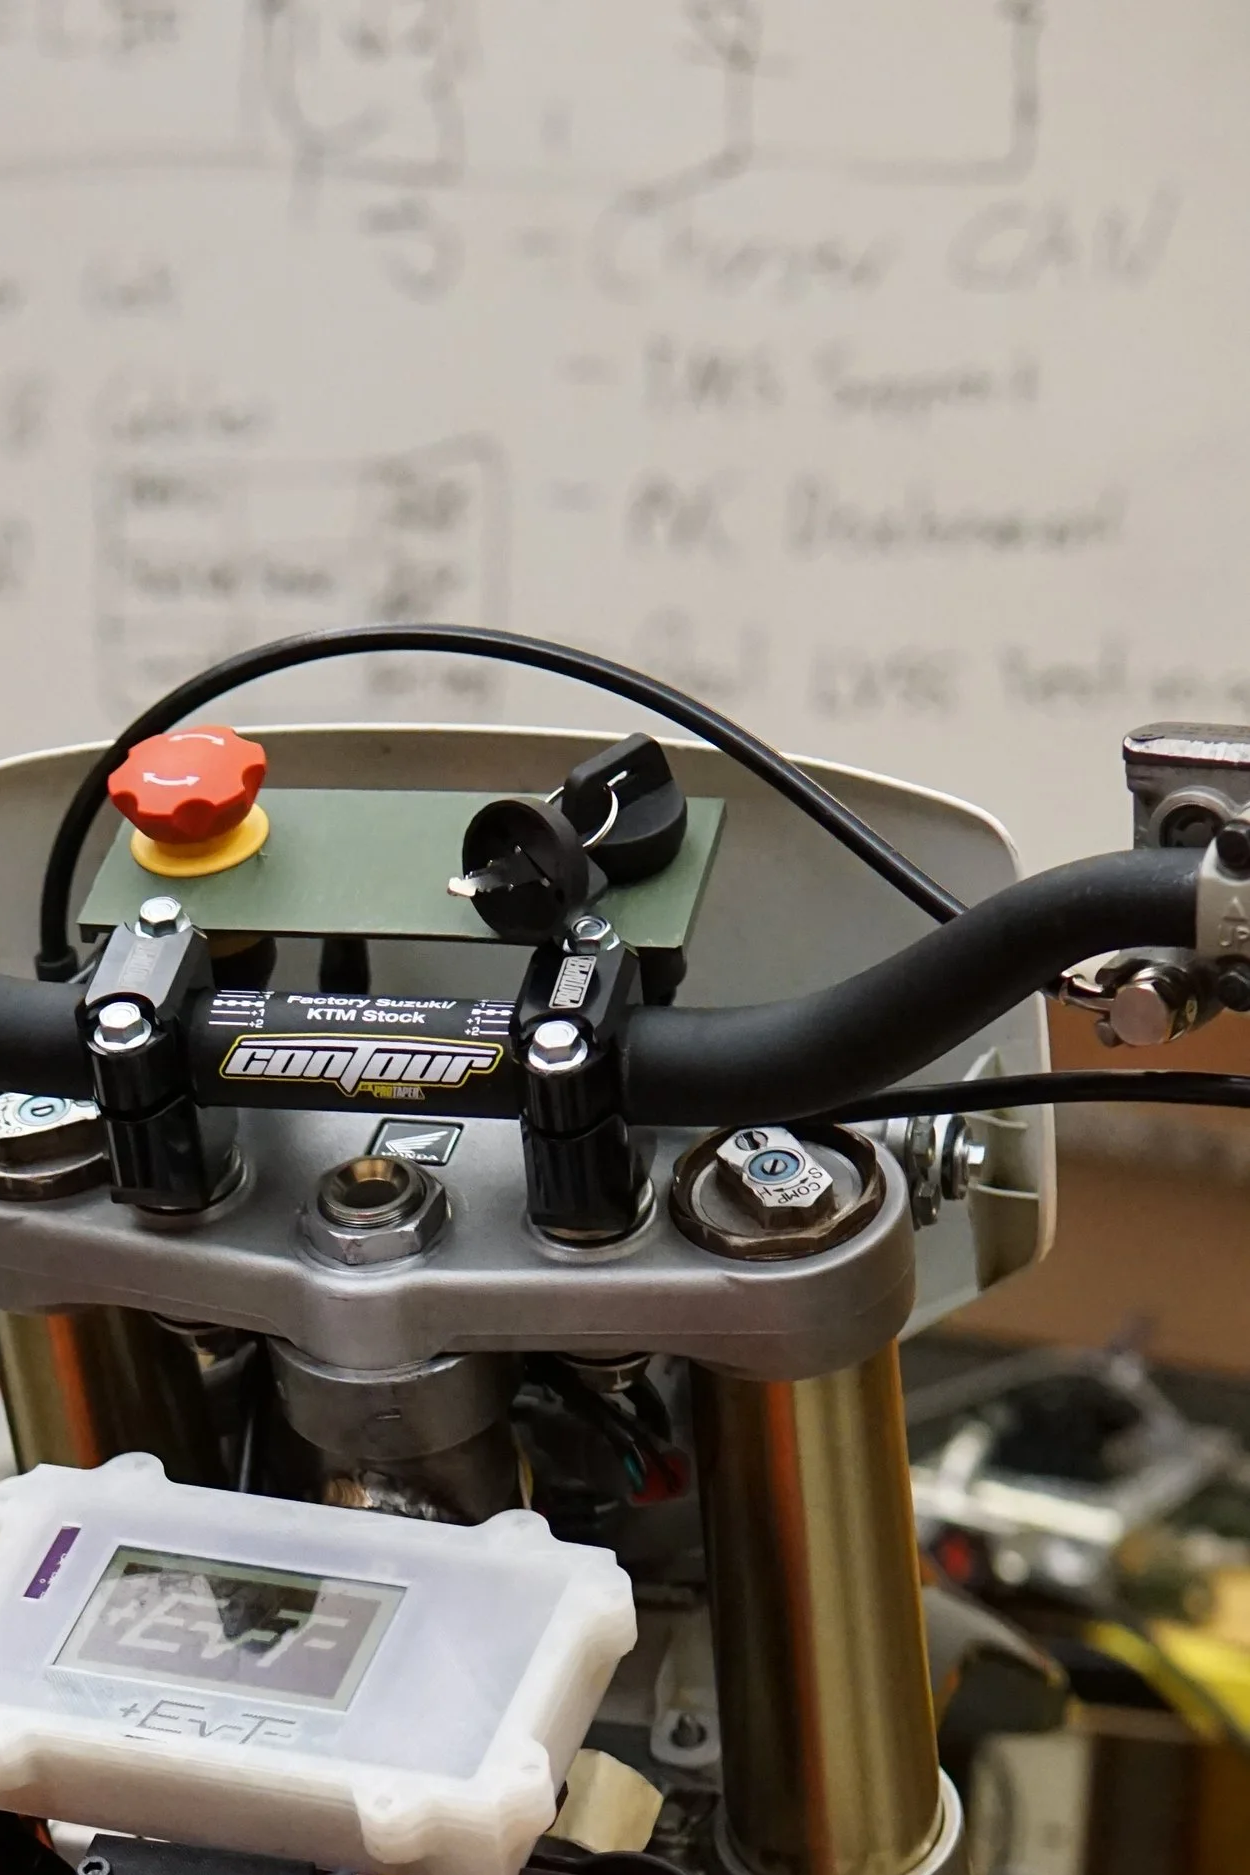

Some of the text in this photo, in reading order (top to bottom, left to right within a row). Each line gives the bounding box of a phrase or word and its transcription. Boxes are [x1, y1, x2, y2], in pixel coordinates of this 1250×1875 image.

[287, 995, 457, 1010] Factory Suzuki/
[249, 1018, 264, 1029] +2
[307, 1008, 426, 1024] KTM Stock
[464, 1026, 480, 1036] +2
[777, 1181, 821, 1205] COMP
